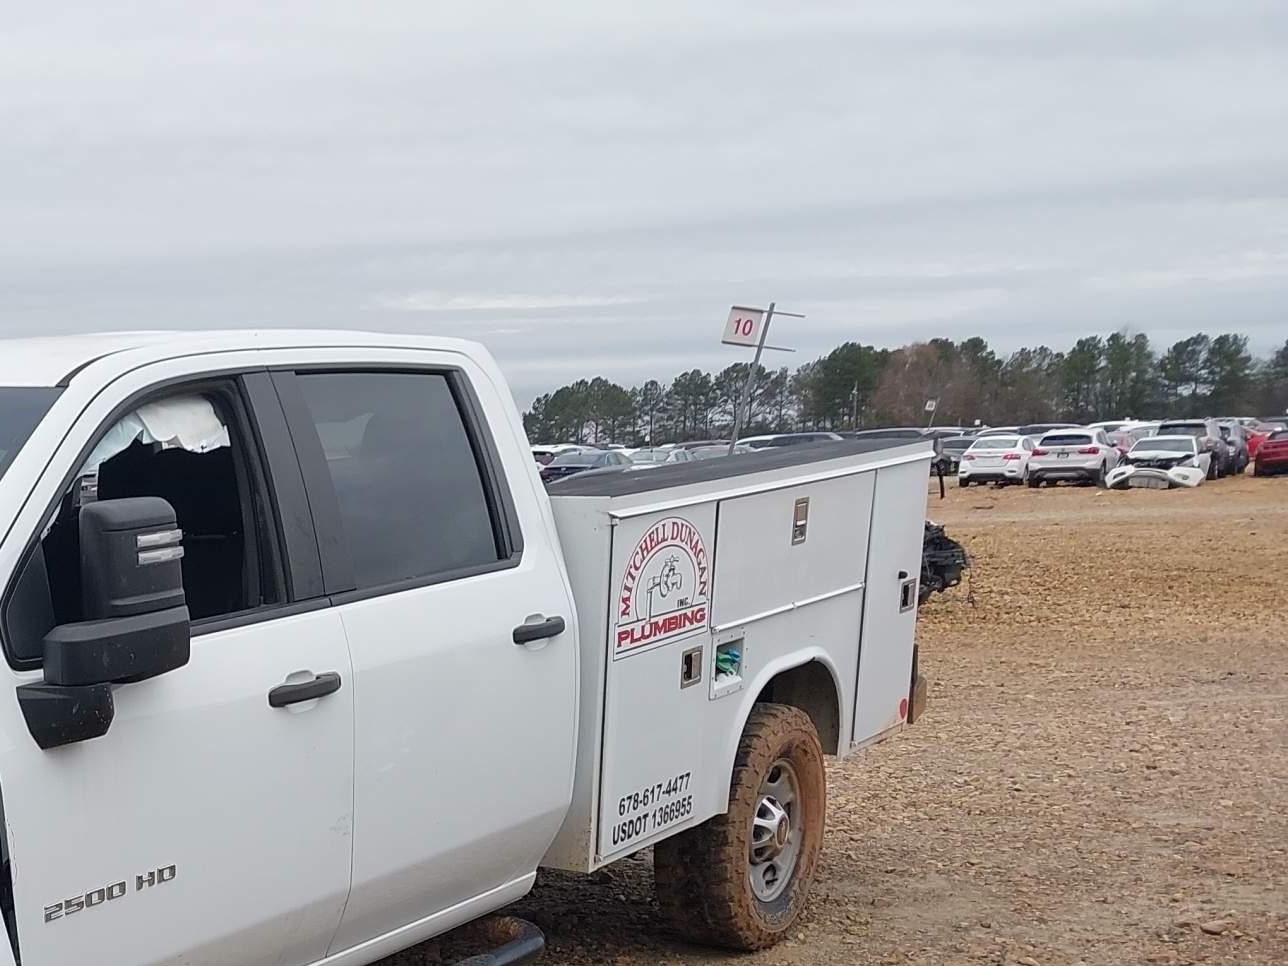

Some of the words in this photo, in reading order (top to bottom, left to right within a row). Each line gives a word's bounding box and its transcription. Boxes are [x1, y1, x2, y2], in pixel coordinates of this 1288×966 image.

[734, 318, 753, 336] 10
[620, 523, 669, 618] MITCHELL
[671, 521, 707, 597] DUNAGAN
[617, 607, 706, 648] PLUMBING
[618, 772, 691, 816] 678-617-4477
[612, 813, 650, 846] USDOT
[652, 795, 693, 829] 1366955
[43, 880, 127, 924] 2500
[135, 864, 177, 892] HD
